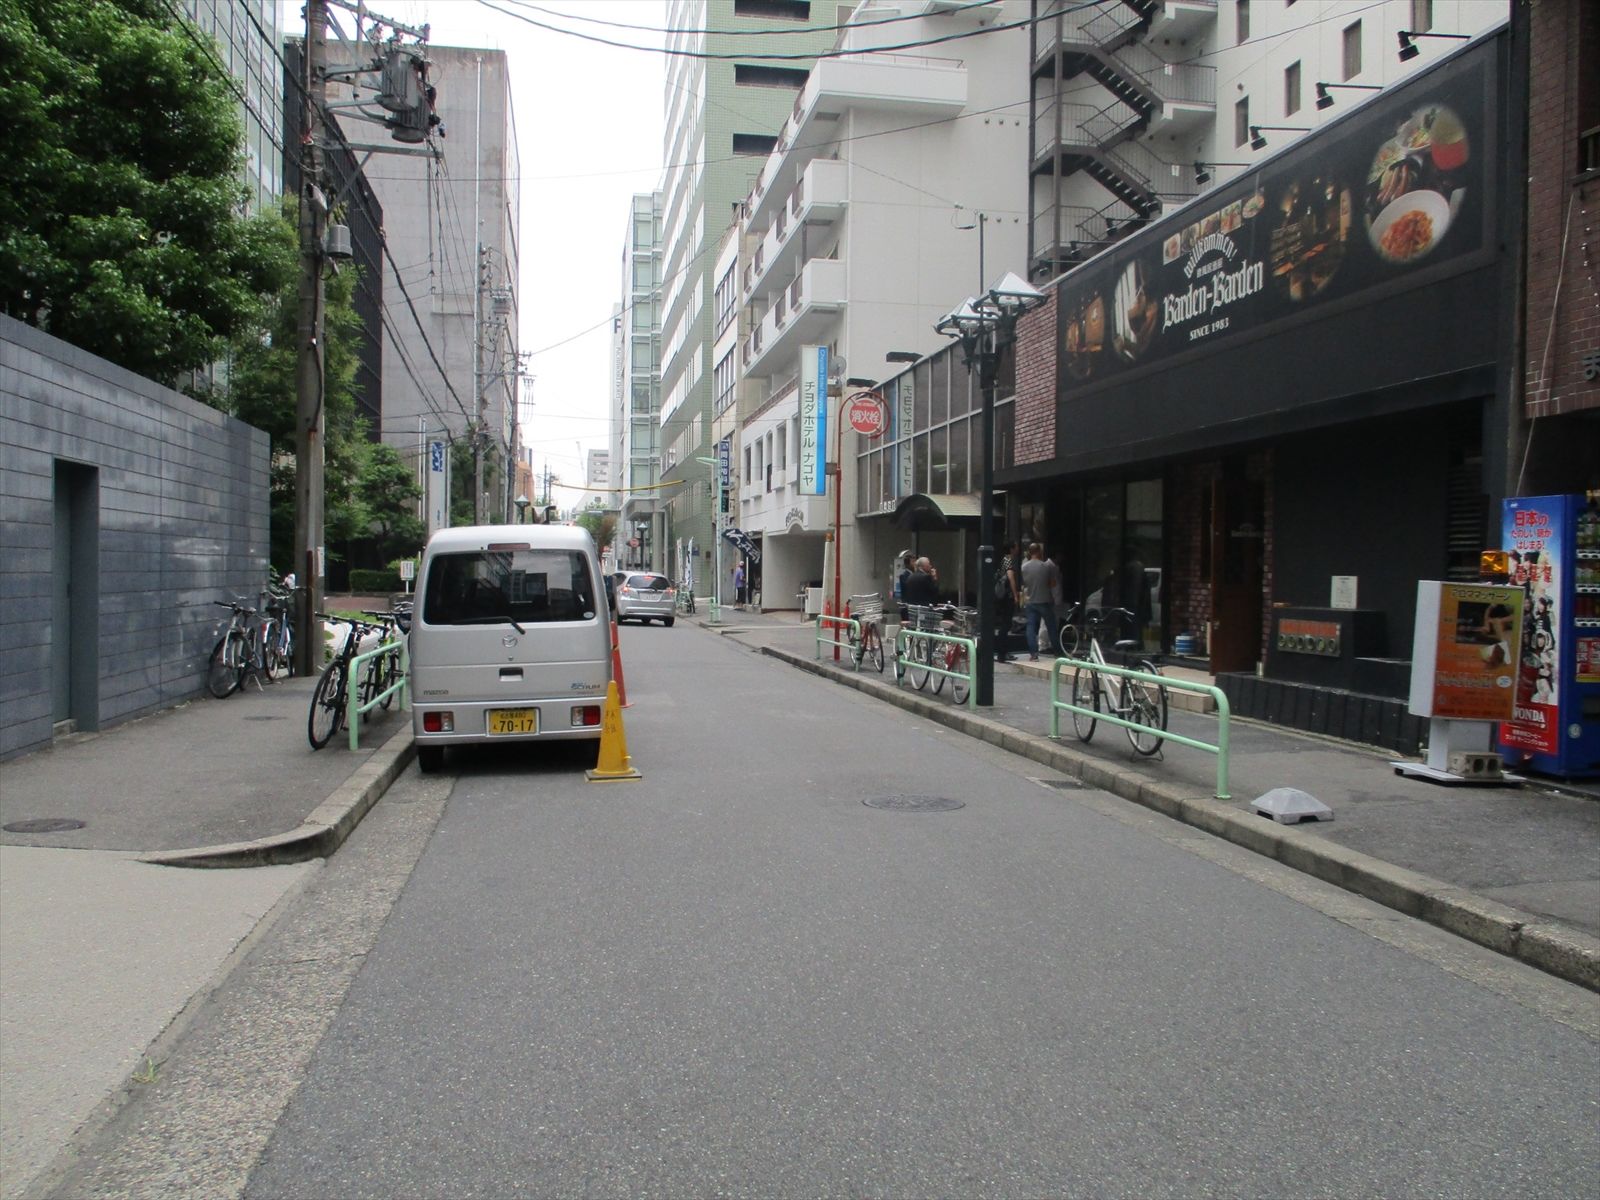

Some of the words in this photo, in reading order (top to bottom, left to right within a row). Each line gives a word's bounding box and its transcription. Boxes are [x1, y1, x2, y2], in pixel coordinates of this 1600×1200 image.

[1162, 259, 1264, 335] Barden-Barden
[1189, 325, 1210, 341] SINCE
[1211, 317, 1230, 333] 1983
[803, 381, 815, 448] チヨダホテル
[851, 409, 880, 424] 消火栓
[803, 452, 814, 486] ナゴヤ
[1514, 510, 1549, 527] 日本の
[499, 719, 534, 732] 70-17
